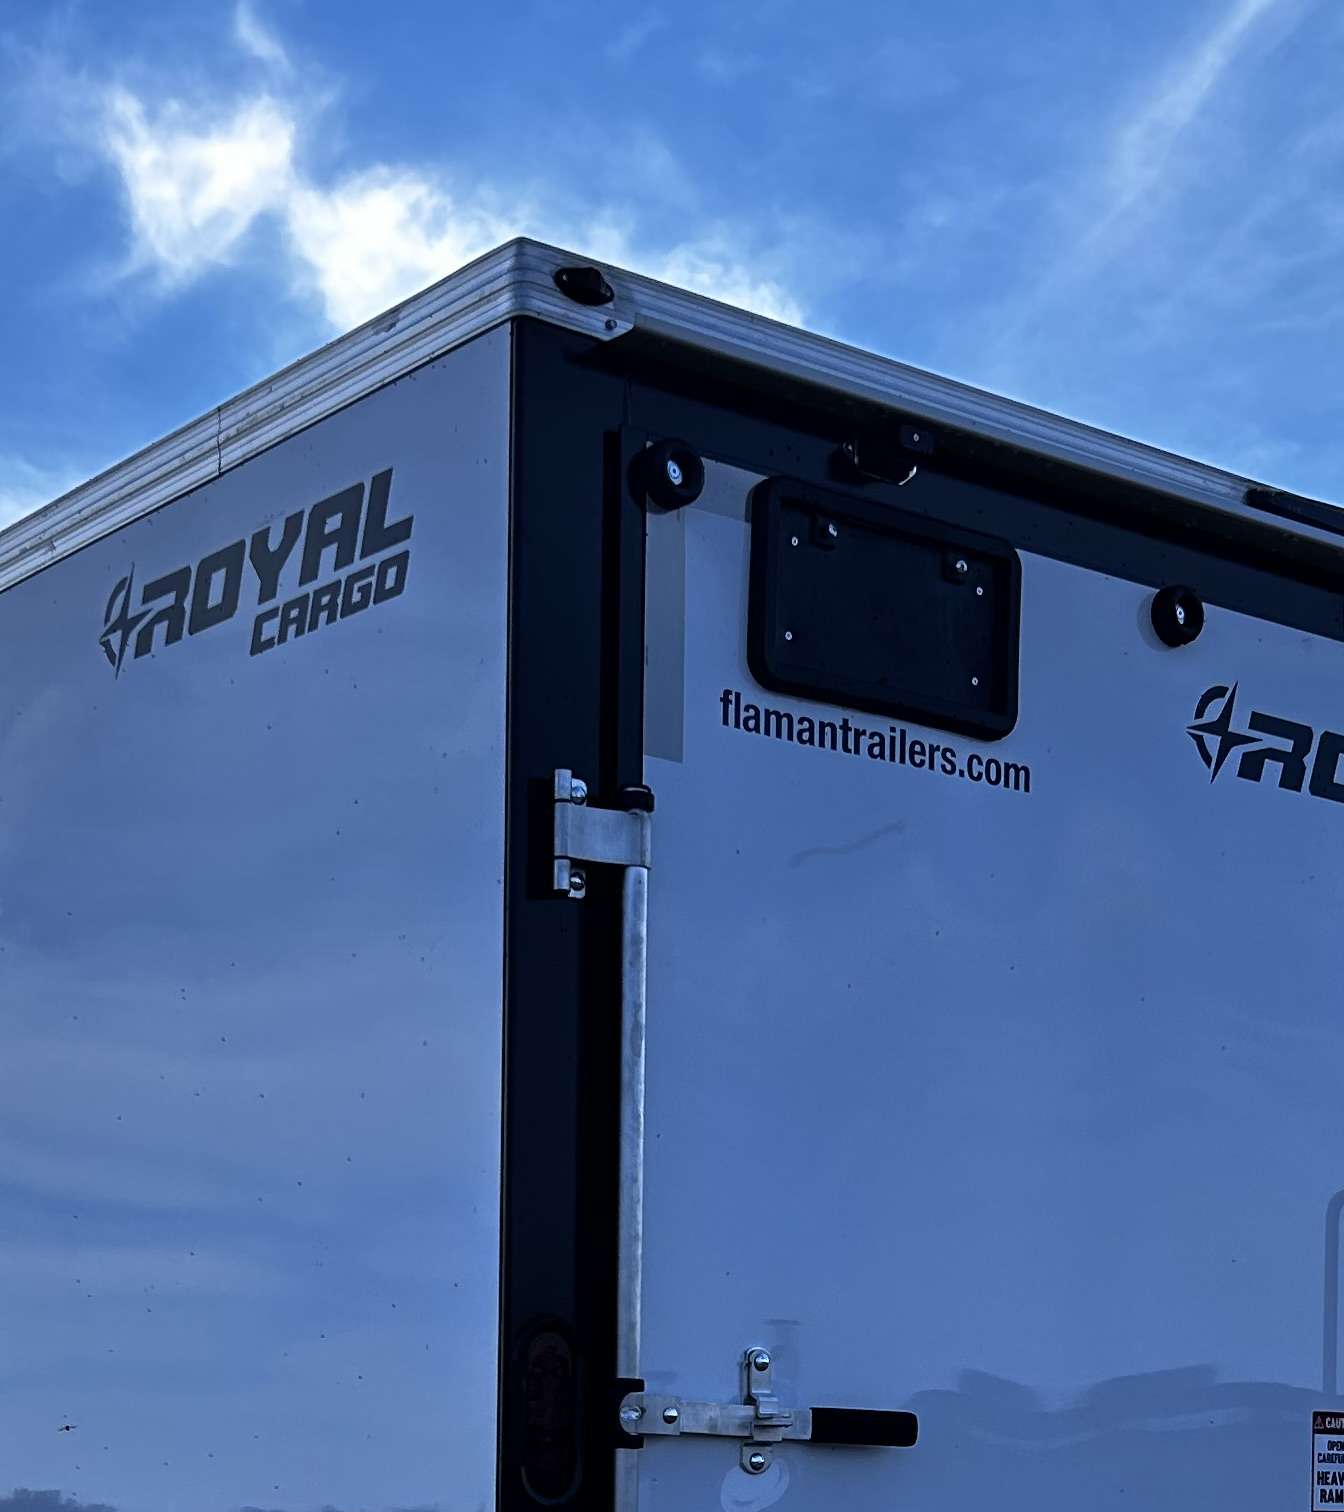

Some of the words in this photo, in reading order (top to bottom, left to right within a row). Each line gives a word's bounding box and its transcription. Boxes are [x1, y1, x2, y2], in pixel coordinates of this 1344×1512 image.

[133, 468, 414, 659] ROYAL
[249, 550, 410, 657] CARGO
[719, 689, 1032, 793] flamantrailers.com
